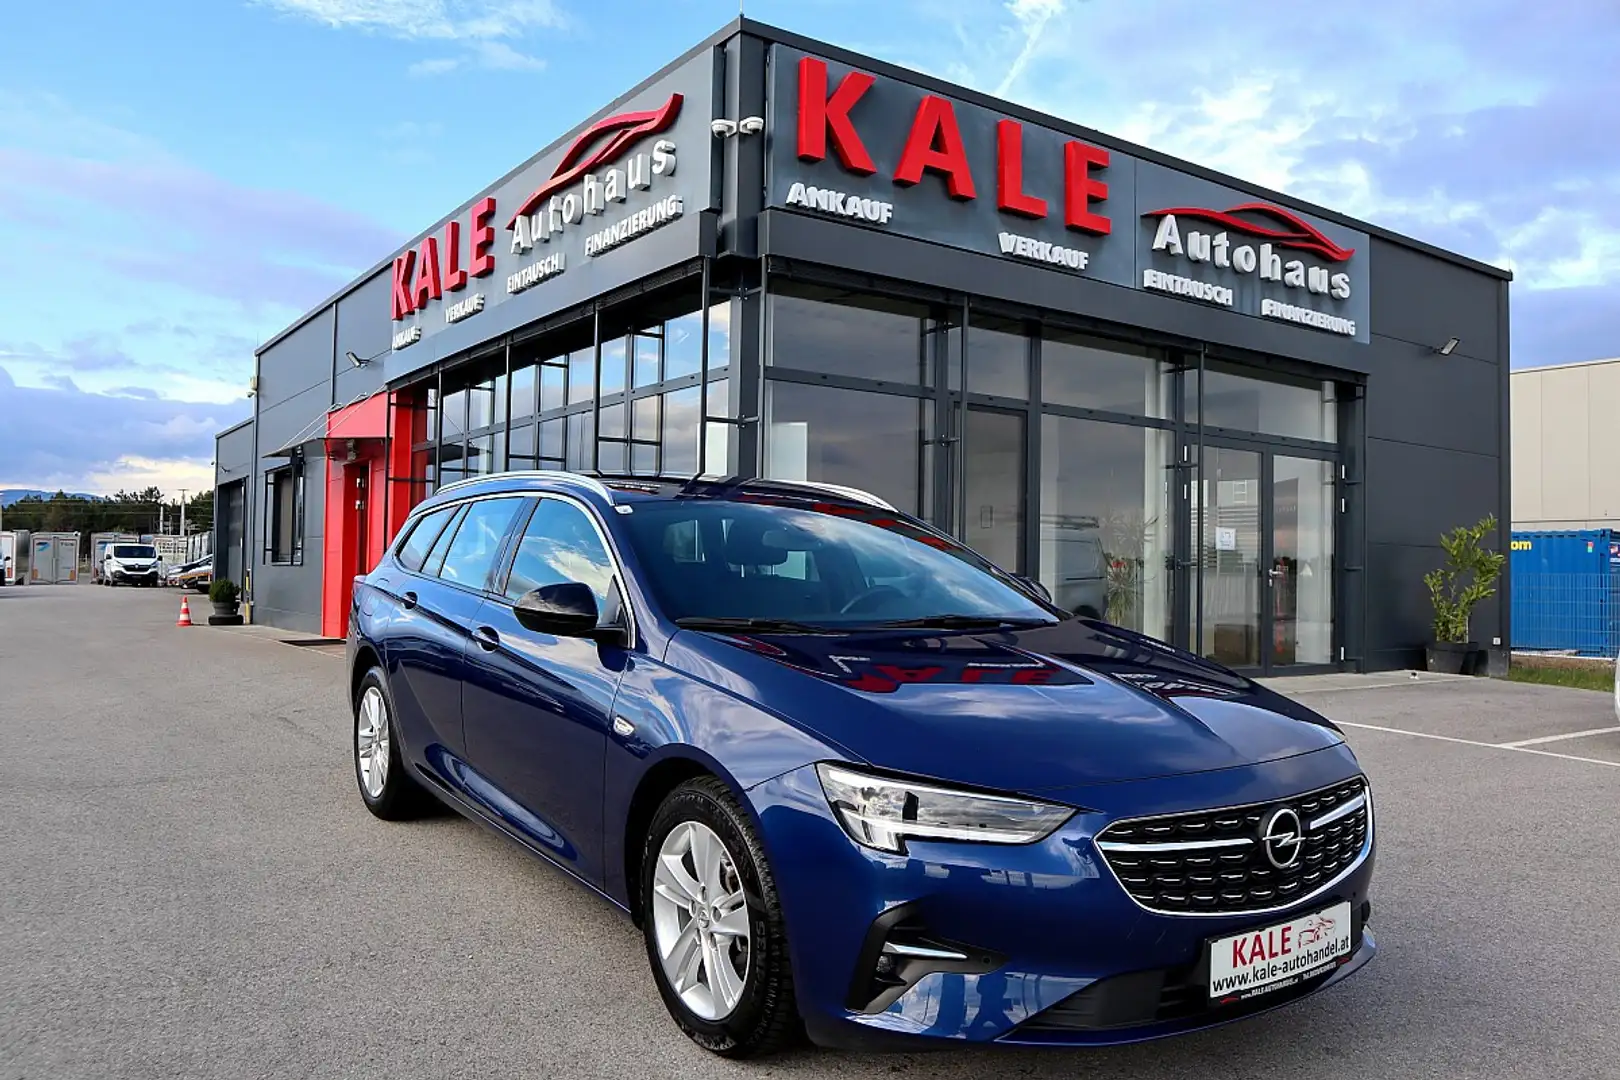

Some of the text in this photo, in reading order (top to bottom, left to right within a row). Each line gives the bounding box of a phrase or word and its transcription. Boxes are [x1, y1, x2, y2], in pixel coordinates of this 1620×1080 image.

[391, 139, 676, 320] KALE Autohaus
[797, 56, 1351, 300] KALE Autohaus
[445, 293, 485, 324] VERKAUF
[507, 252, 566, 293] EINTAUSCH
[585, 194, 683, 256] FINANZIERUNG
[786, 183, 1356, 336] ANKAUF VERKAUF EINTAUSCH FINANZIERUNG
[1212, 935, 1349, 992] www.kale-autohandel.at
[1232, 926, 1291, 968] KALE
